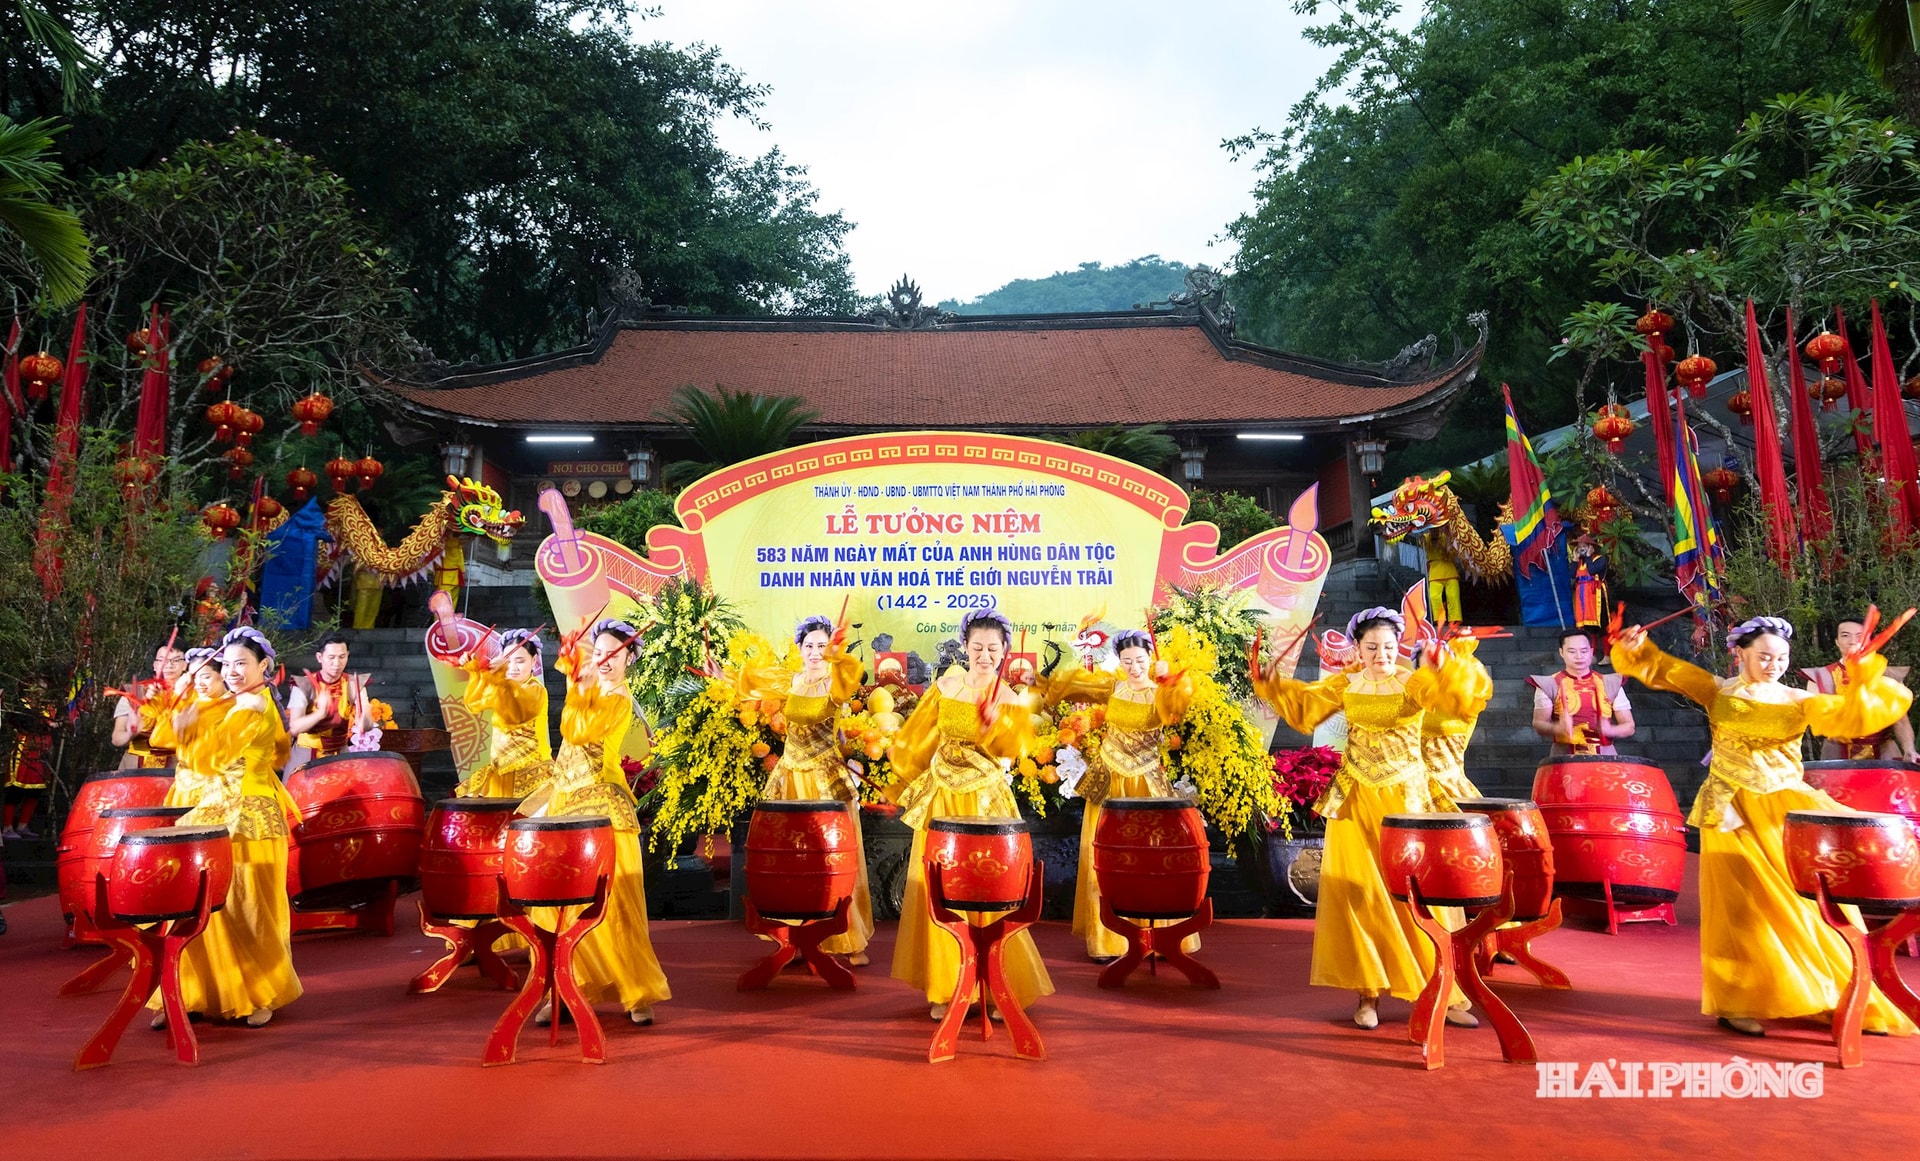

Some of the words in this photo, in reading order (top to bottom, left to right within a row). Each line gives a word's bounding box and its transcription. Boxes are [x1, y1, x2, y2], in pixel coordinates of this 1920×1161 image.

[814, 483, 839, 497] THÀNH
[841, 481, 852, 497] ỦY
[858, 486, 879, 497] HĐND
[885, 486, 906, 497] UBND
[912, 486, 943, 497] UBMTTQ
[944, 482, 960, 499] VIỆT
[962, 486, 980, 496] NAM
[982, 482, 1006, 496] THÀNH
[1008, 480, 1024, 496] PHỐ
[1025, 480, 1037, 496] HẢI
[1039, 481, 1065, 496] PHÒNG
[826, 505, 858, 534] LỄ
[865, 507, 964, 534] TƯỞNG
[972, 508, 1041, 538] NIỆM
[757, 548, 786, 562] 583
[792, 545, 829, 562] NĂM
[834, 544, 877, 562] NGÀY
[882, 542, 917, 562] MẤT
[922, 540, 954, 561] CỦA
[959, 546, 992, 561] ANH
[998, 544, 1042, 561] HÙNG
[1047, 543, 1080, 560] DÂN
[1085, 542, 1115, 563] TỘC
[760, 572, 805, 587] DANH
[810, 569, 855, 587] NHÂN
[861, 569, 893, 586] VĂN
[898, 569, 930, 586] HOÁ
[935, 566, 964, 586] THẾ
[970, 567, 1002, 586] GIỚI
[1007, 565, 1072, 585] NGUYỄN
[1077, 567, 1112, 585] TRÃI
[877, 595, 927, 611] (1442
[947, 594, 997, 609] 2025)
[916, 622, 937, 633] Côn
